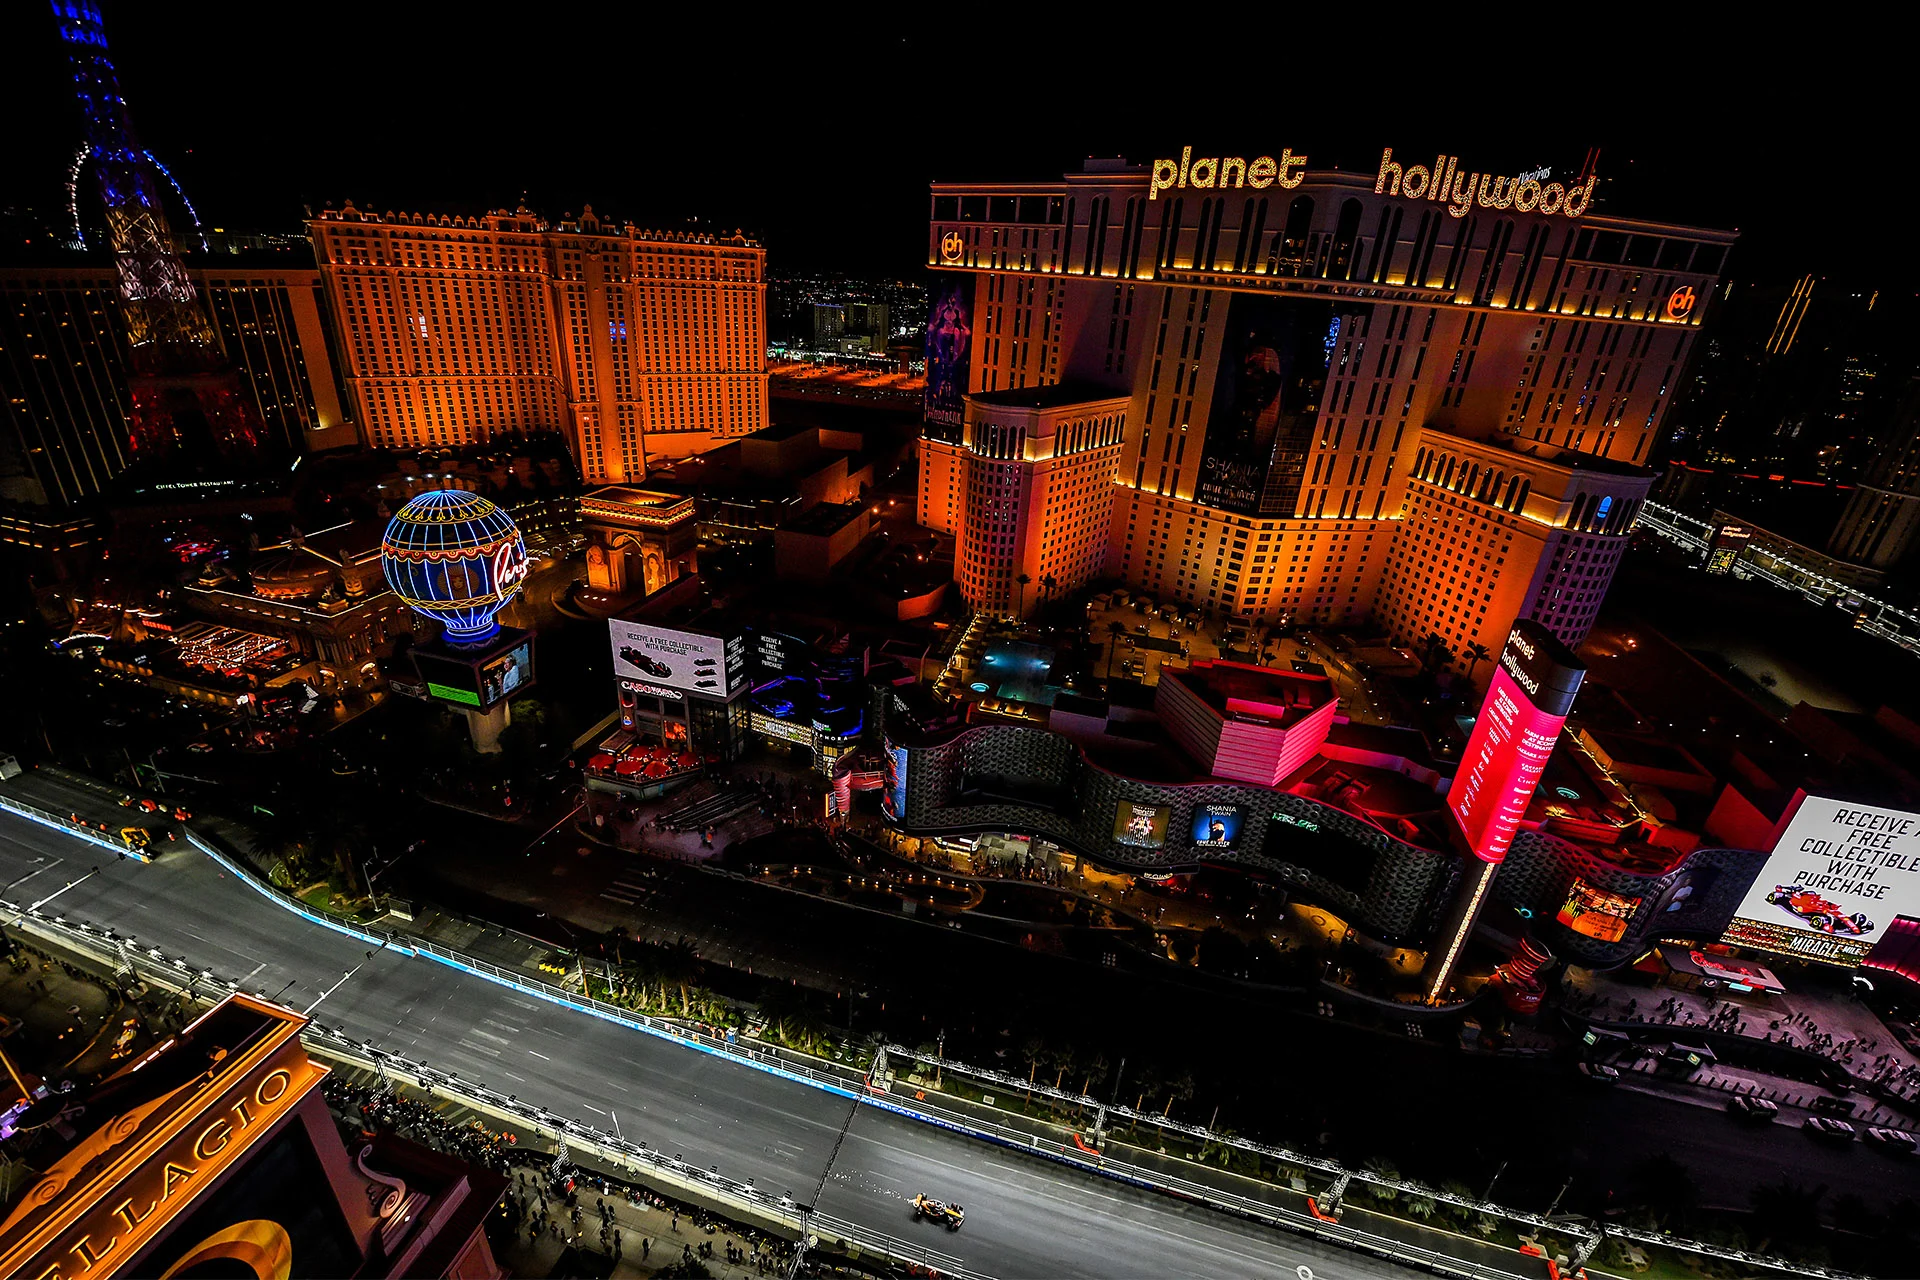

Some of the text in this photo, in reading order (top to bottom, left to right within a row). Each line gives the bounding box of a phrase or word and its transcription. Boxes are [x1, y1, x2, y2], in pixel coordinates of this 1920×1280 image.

[1149, 146, 1597, 218] planet hollywood
[493, 542, 541, 602] Paris
[626, 632, 649, 643] RECEIVE
[654, 638, 670, 647] FREE
[669, 640, 704, 653] COLLECTIBLE
[644, 641, 688, 657] WITH PURCHASE
[757, 646, 785, 659] COLLECTIBLE
[760, 635, 778, 645] RECEIVE
[765, 642, 777, 651] FREE
[1507, 629, 1535, 661] planet
[761, 659, 783, 670] PURCHASE
[1501, 646, 1540, 695] hollywood
[1206, 804, 1237, 813] SHANIA
[1832, 808, 1915, 835] RECEIVE
[1846, 829, 1899, 850] FREE
[1799, 838, 1920, 872] COLLECTIBLE
[1826, 860, 1878, 881] WITH
[1792, 871, 1891, 900] PURCHASE
[1789, 935, 1844, 959] MIRACLE
[1841, 945, 1861, 956] MILE
[711, 1050, 825, 1089] AMERICAN EXPRESS
[853, 1095, 977, 1137] AMERICAN EXPRESS
[1007, 1143, 1145, 1187] AMERICAN EXPRESS
